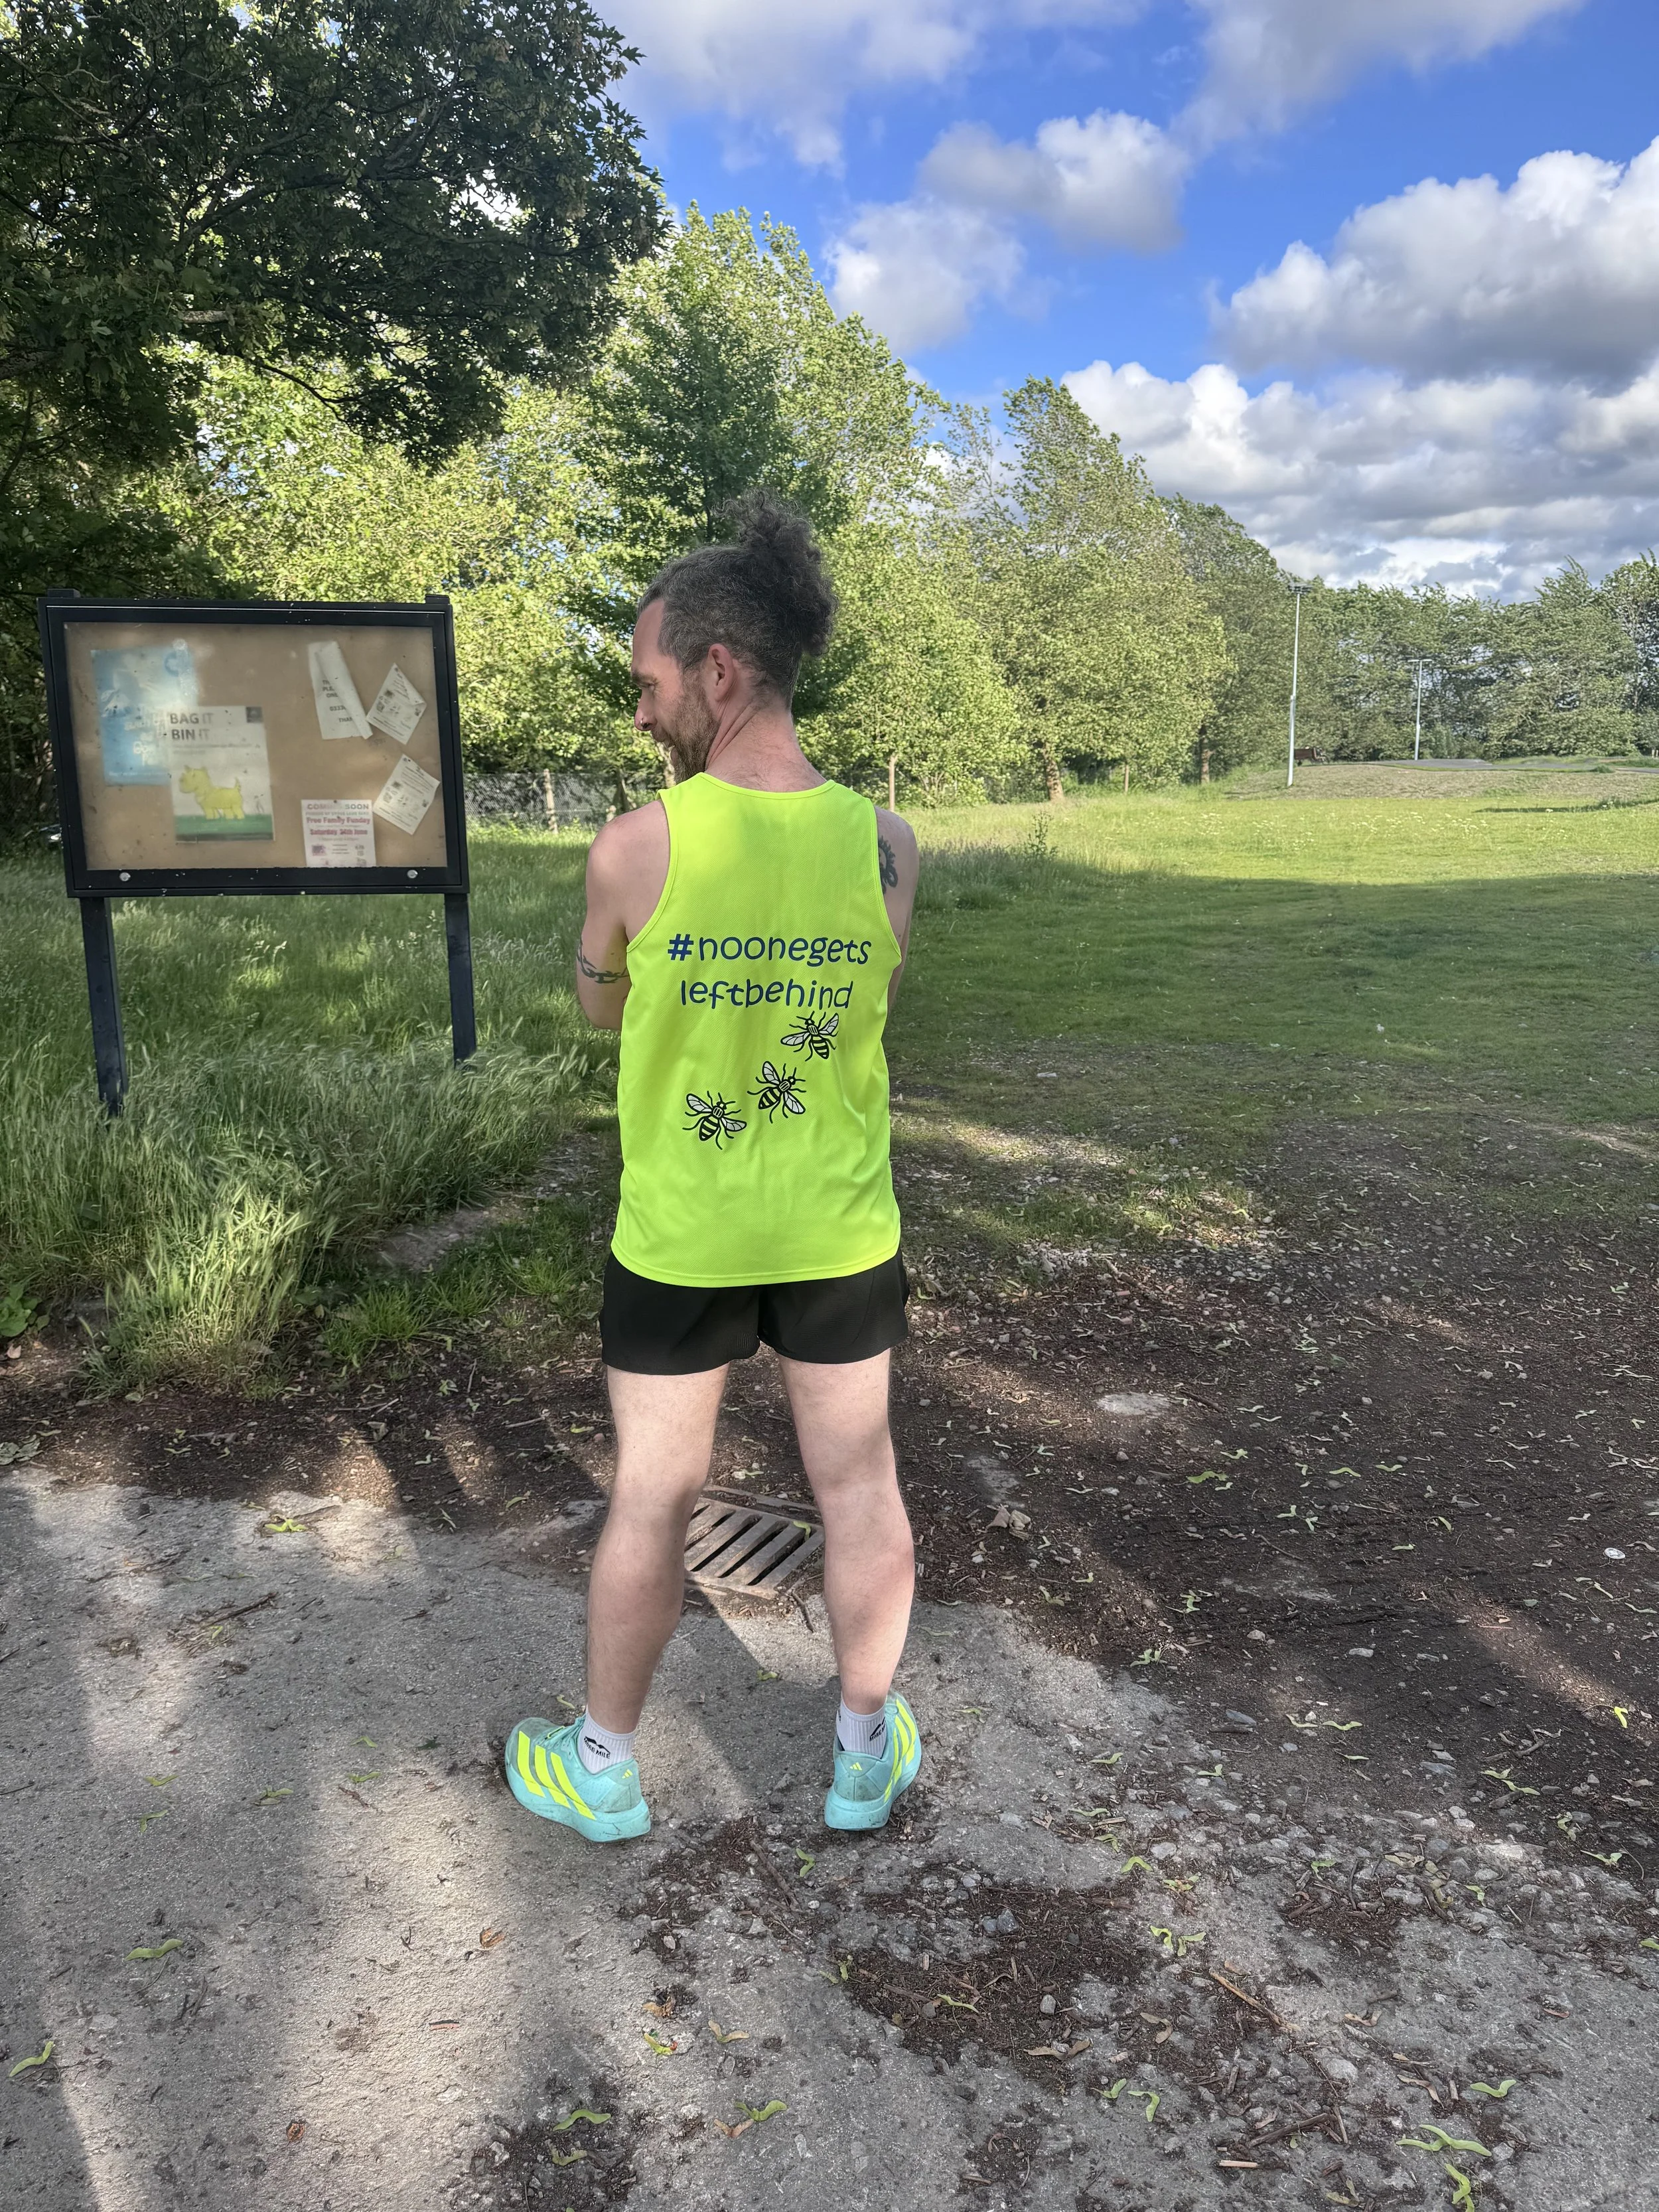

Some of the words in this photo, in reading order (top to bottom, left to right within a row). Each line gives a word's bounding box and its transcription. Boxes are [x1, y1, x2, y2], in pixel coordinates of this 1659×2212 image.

[170, 713, 199, 724] BAG
[202, 713, 214, 724] IT
[171, 729, 196, 740] BIN
[668, 934, 871, 967] #noonegets
[681, 978, 853, 1010] leftbehind
[596, 1749, 610, 1759] MILE
